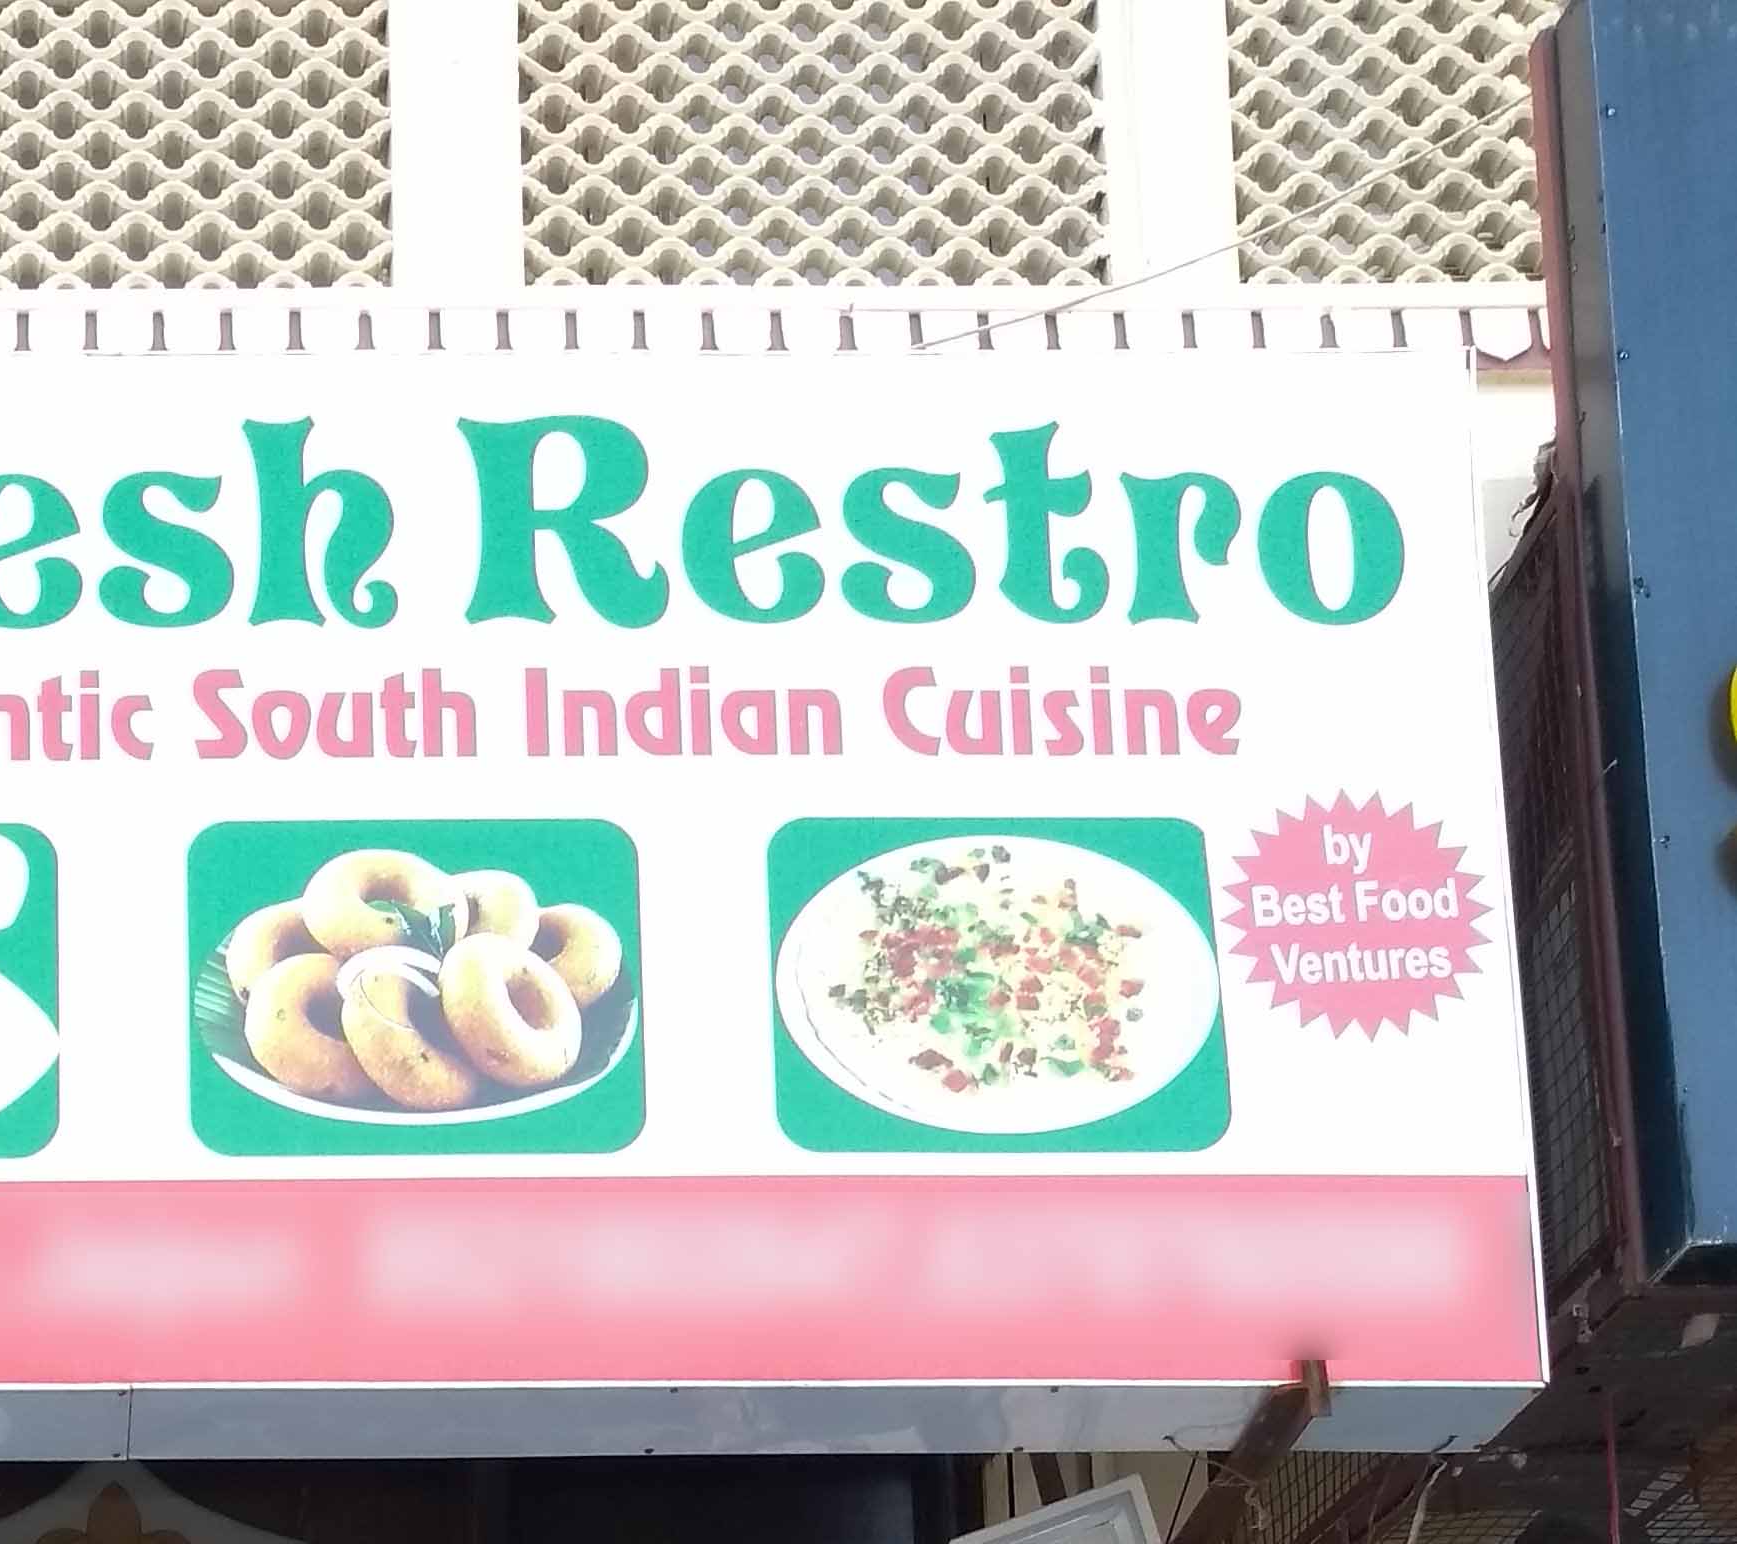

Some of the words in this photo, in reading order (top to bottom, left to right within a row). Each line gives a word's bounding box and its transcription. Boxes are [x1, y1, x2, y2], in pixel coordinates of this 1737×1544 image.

[456, 415, 1404, 630] Restro
[192, 668, 478, 760] South
[524, 666, 843, 757] Indian
[882, 665, 1243, 757] Cuisine
[1323, 824, 1372, 874] by
[1251, 884, 1346, 928] Best
[1354, 877, 1460, 922] Food
[1270, 942, 1453, 985] Ventures
